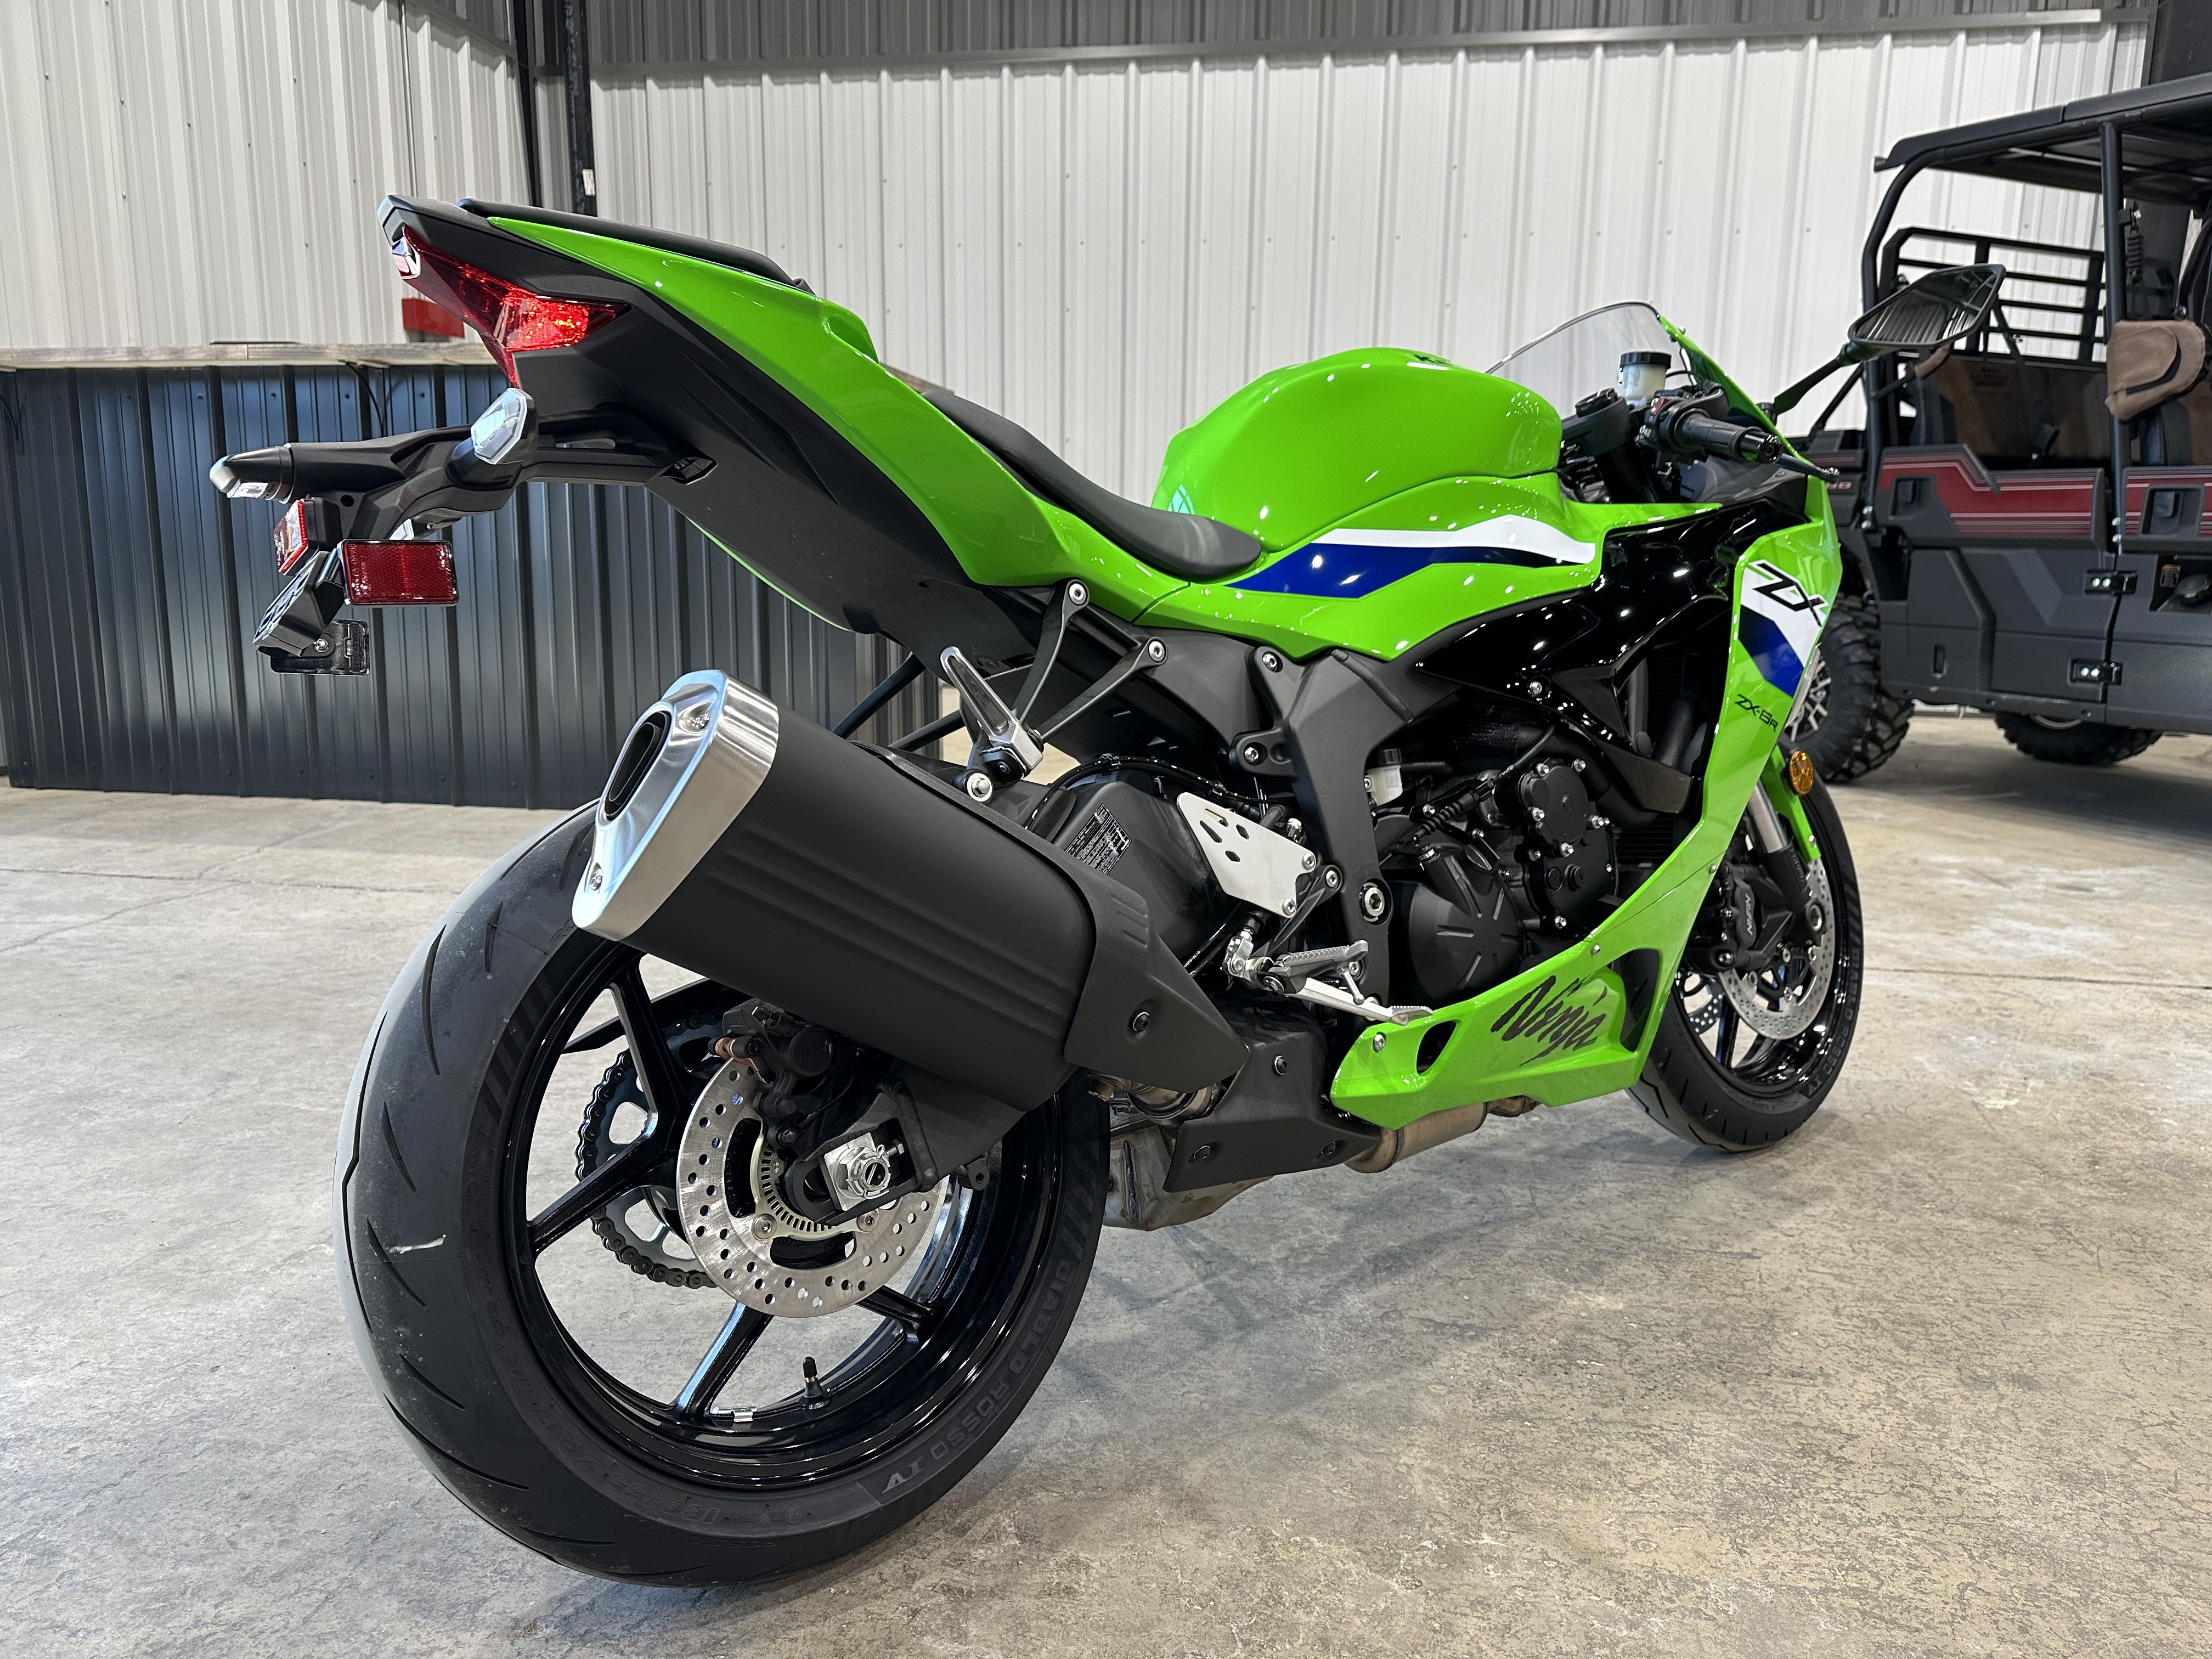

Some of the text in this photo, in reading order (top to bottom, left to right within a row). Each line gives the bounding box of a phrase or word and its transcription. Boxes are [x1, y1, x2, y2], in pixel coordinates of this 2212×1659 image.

[1753, 562, 1826, 627] ZX
[1735, 693, 1779, 732] ZX-6R
[1491, 974, 1607, 1066] Ninja
[1807, 947, 1860, 1097] DIABLO ROSSO IV
[882, 1259, 1076, 1494] DIABLO ROSSO IV
